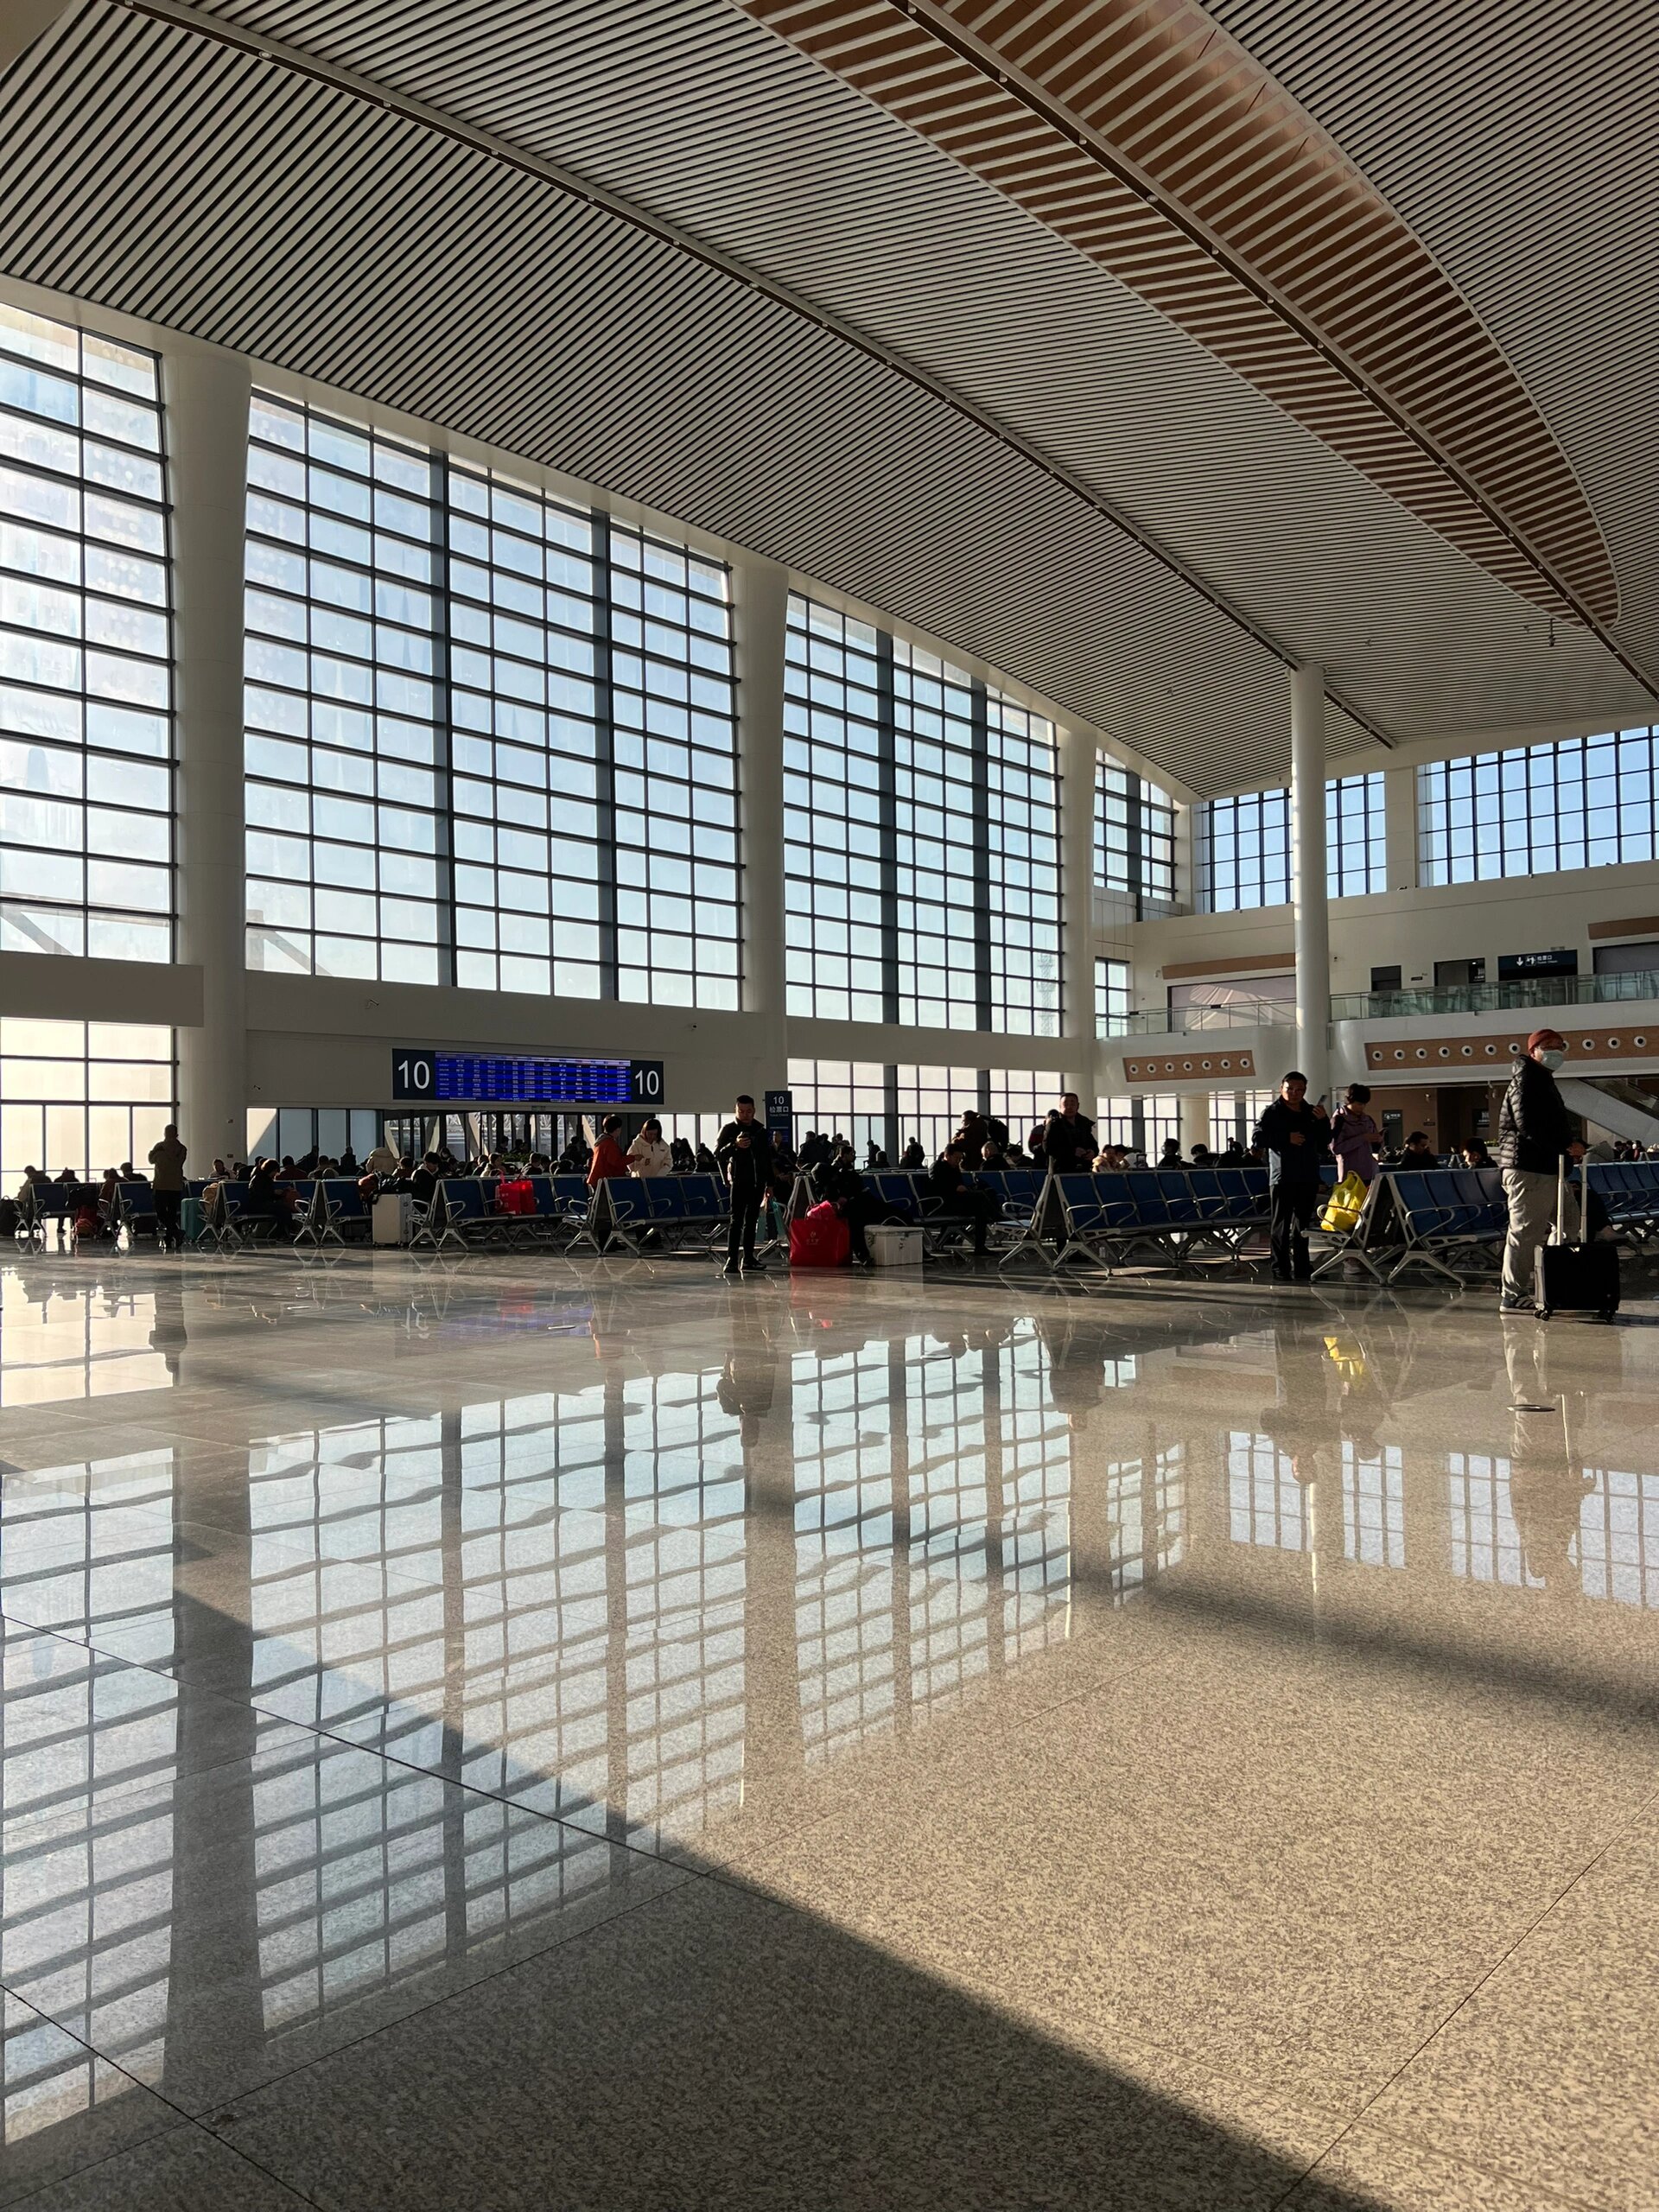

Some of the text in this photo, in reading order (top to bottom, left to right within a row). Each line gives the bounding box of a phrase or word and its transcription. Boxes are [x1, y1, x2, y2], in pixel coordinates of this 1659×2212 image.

[397, 1060, 430, 1090] 10
[634, 1070, 659, 1096] 10
[772, 1096, 785, 1105] 10
